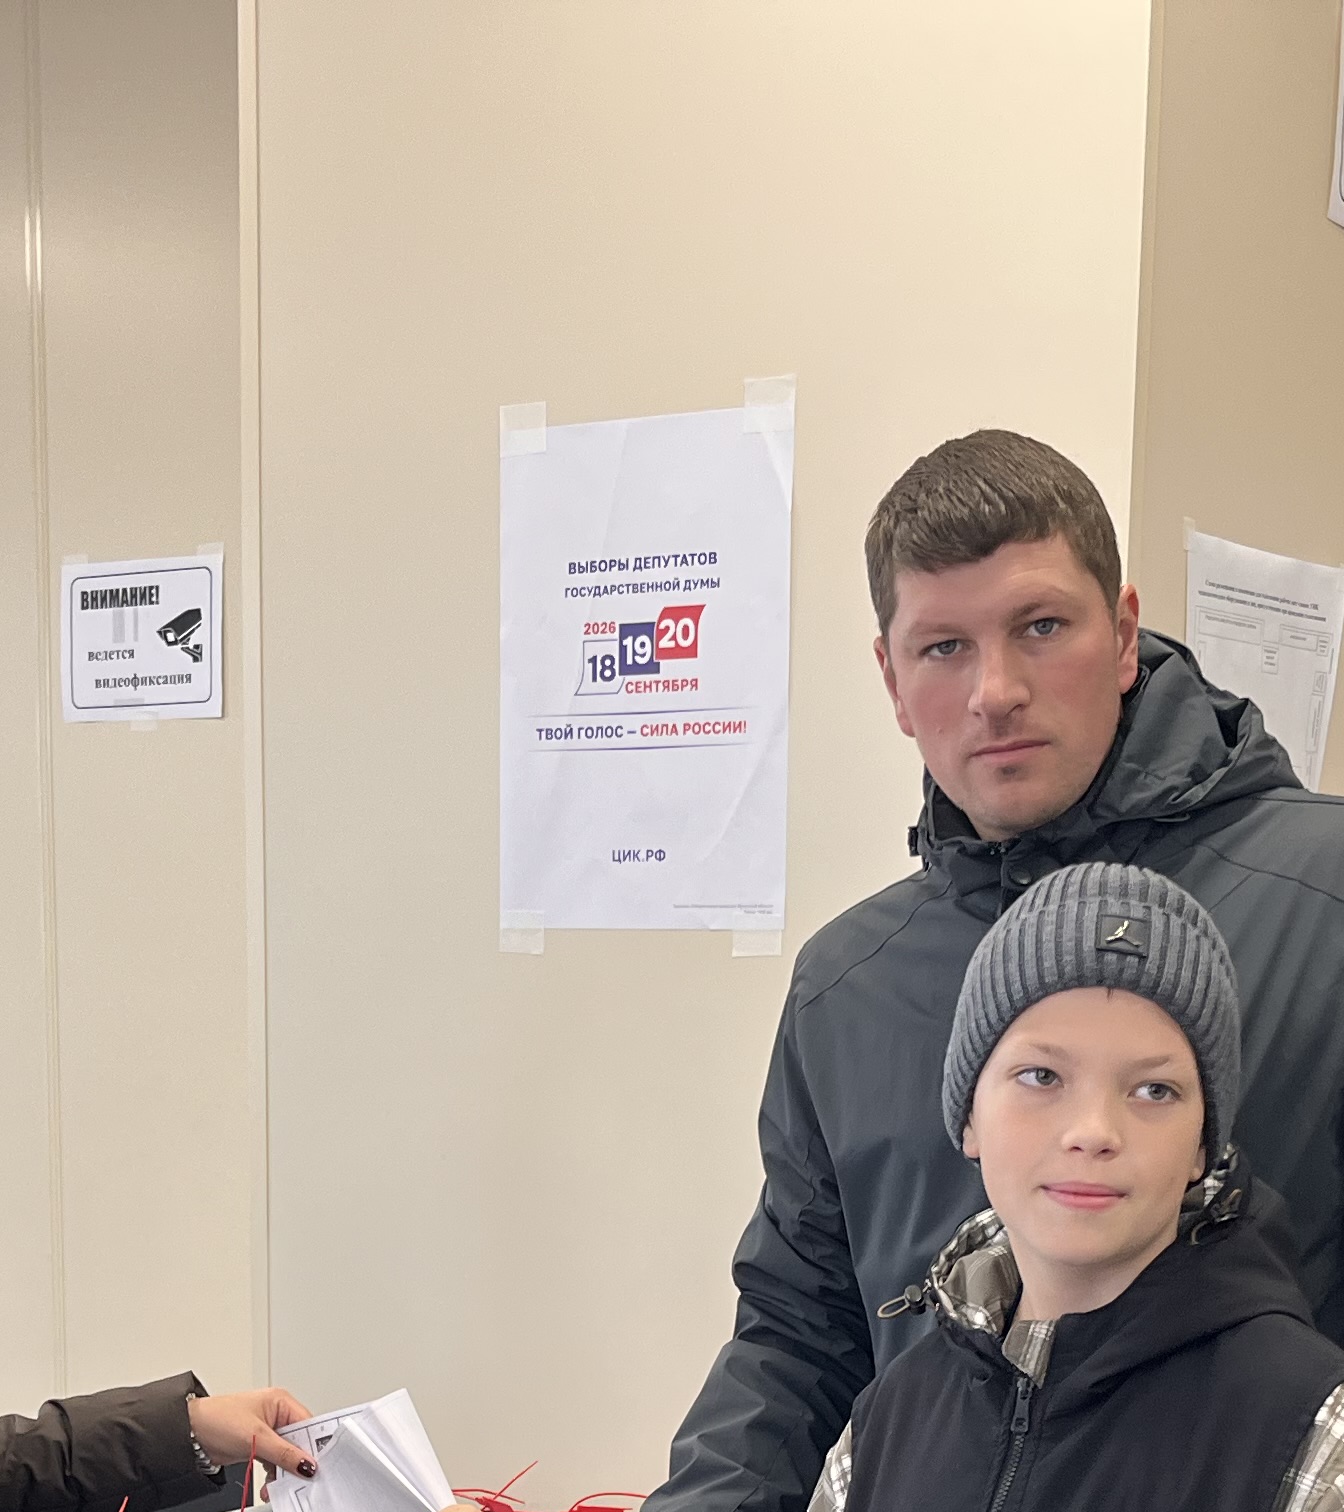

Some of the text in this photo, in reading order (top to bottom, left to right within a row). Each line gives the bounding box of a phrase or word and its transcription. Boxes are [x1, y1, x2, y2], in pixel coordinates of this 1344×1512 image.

[568, 551, 718, 575] ВЫБОРЫ ДЕПУТАТОВ
[80, 585, 159, 610] ВНИМАНИЕ!
[564, 577, 721, 598] ГОСУДАРСТВЕННОЙ ДУМЫ
[583, 617, 696, 665] 2026 19 20
[88, 648, 135, 662] ведется
[587, 654, 617, 682] 18
[95, 673, 192, 691] видеофиксация
[625, 677, 699, 694] СЕНТЯБРЯ
[536, 724, 573, 741] ТВОЙ
[577, 725, 624, 739] ГОЛОС
[640, 722, 679, 737] СИЛА
[683, 720, 747, 736] РОССИИ!
[612, 848, 666, 863] ЦИК.РФ
